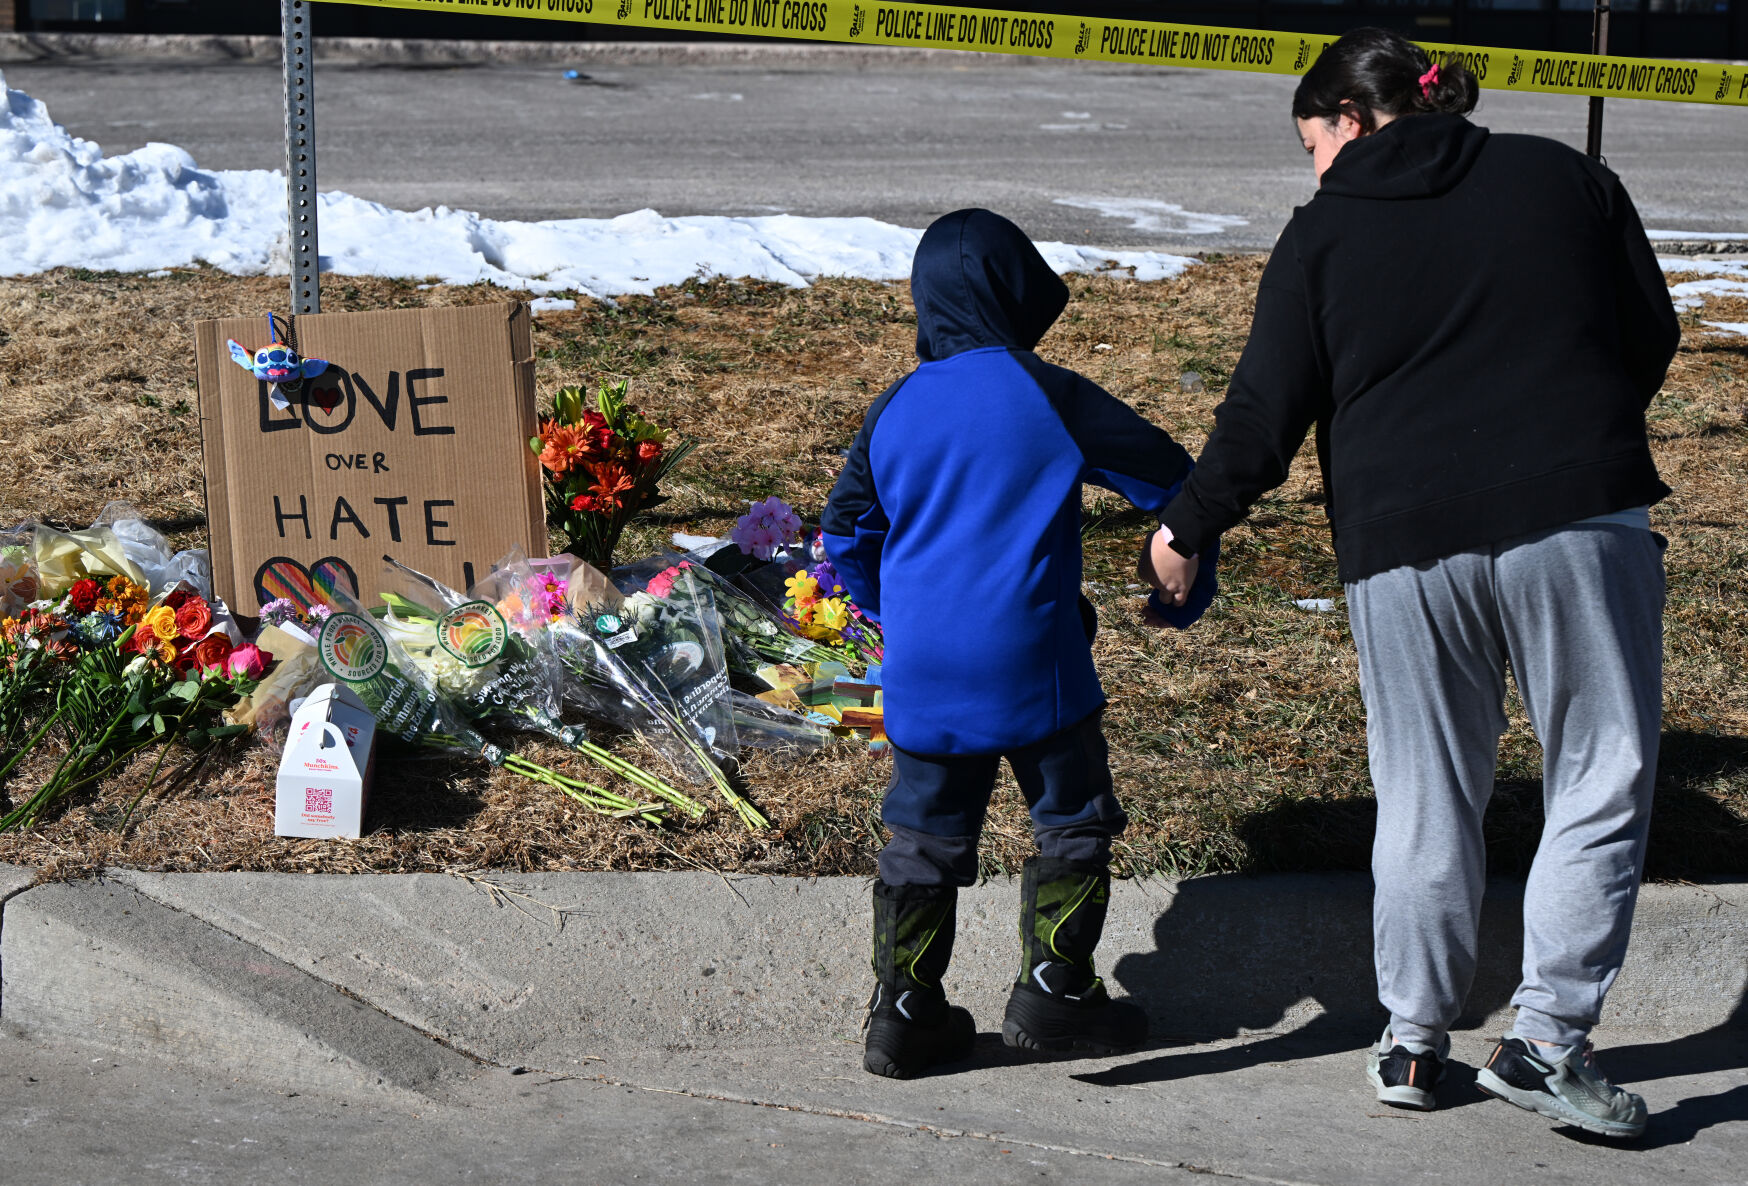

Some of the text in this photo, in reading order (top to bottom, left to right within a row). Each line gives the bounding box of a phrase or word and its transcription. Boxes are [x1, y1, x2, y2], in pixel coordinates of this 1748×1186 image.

[644, 0, 692, 22] POLICE
[695, 0, 724, 24] LINE
[729, 0, 747, 26] DO
[751, 0, 778, 28] NOT
[782, 0, 828, 32] CROSS
[876, 8, 924, 40] POLICE
[925, 11, 956, 42] LINE
[958, 14, 977, 44] DO
[980, 15, 1008, 46] NOT
[1009, 17, 1054, 49] CROSS
[1101, 25, 1148, 56] POLICE
[1149, 29, 1179, 59] LINE
[1180, 31, 1201, 61] DO
[1201, 33, 1230, 62] NOT
[1230, 35, 1275, 66] CROSS
[1531, 58, 1578, 87] POLICE
[1577, 61, 1607, 89] LINE
[1607, 63, 1627, 91] DO
[1627, 65, 1656, 93] NOT
[1655, 66, 1698, 96] CROSS
[257, 362, 456, 436] LOVE
[325, 451, 390, 474] OVER
[273, 494, 457, 546] HATE
[325, 621, 339, 641] FOODS
[325, 643, 338, 667] WHOLE
[347, 631, 383, 677] SOURCED FOR GOOD
[459, 653, 487, 662] SORCED
